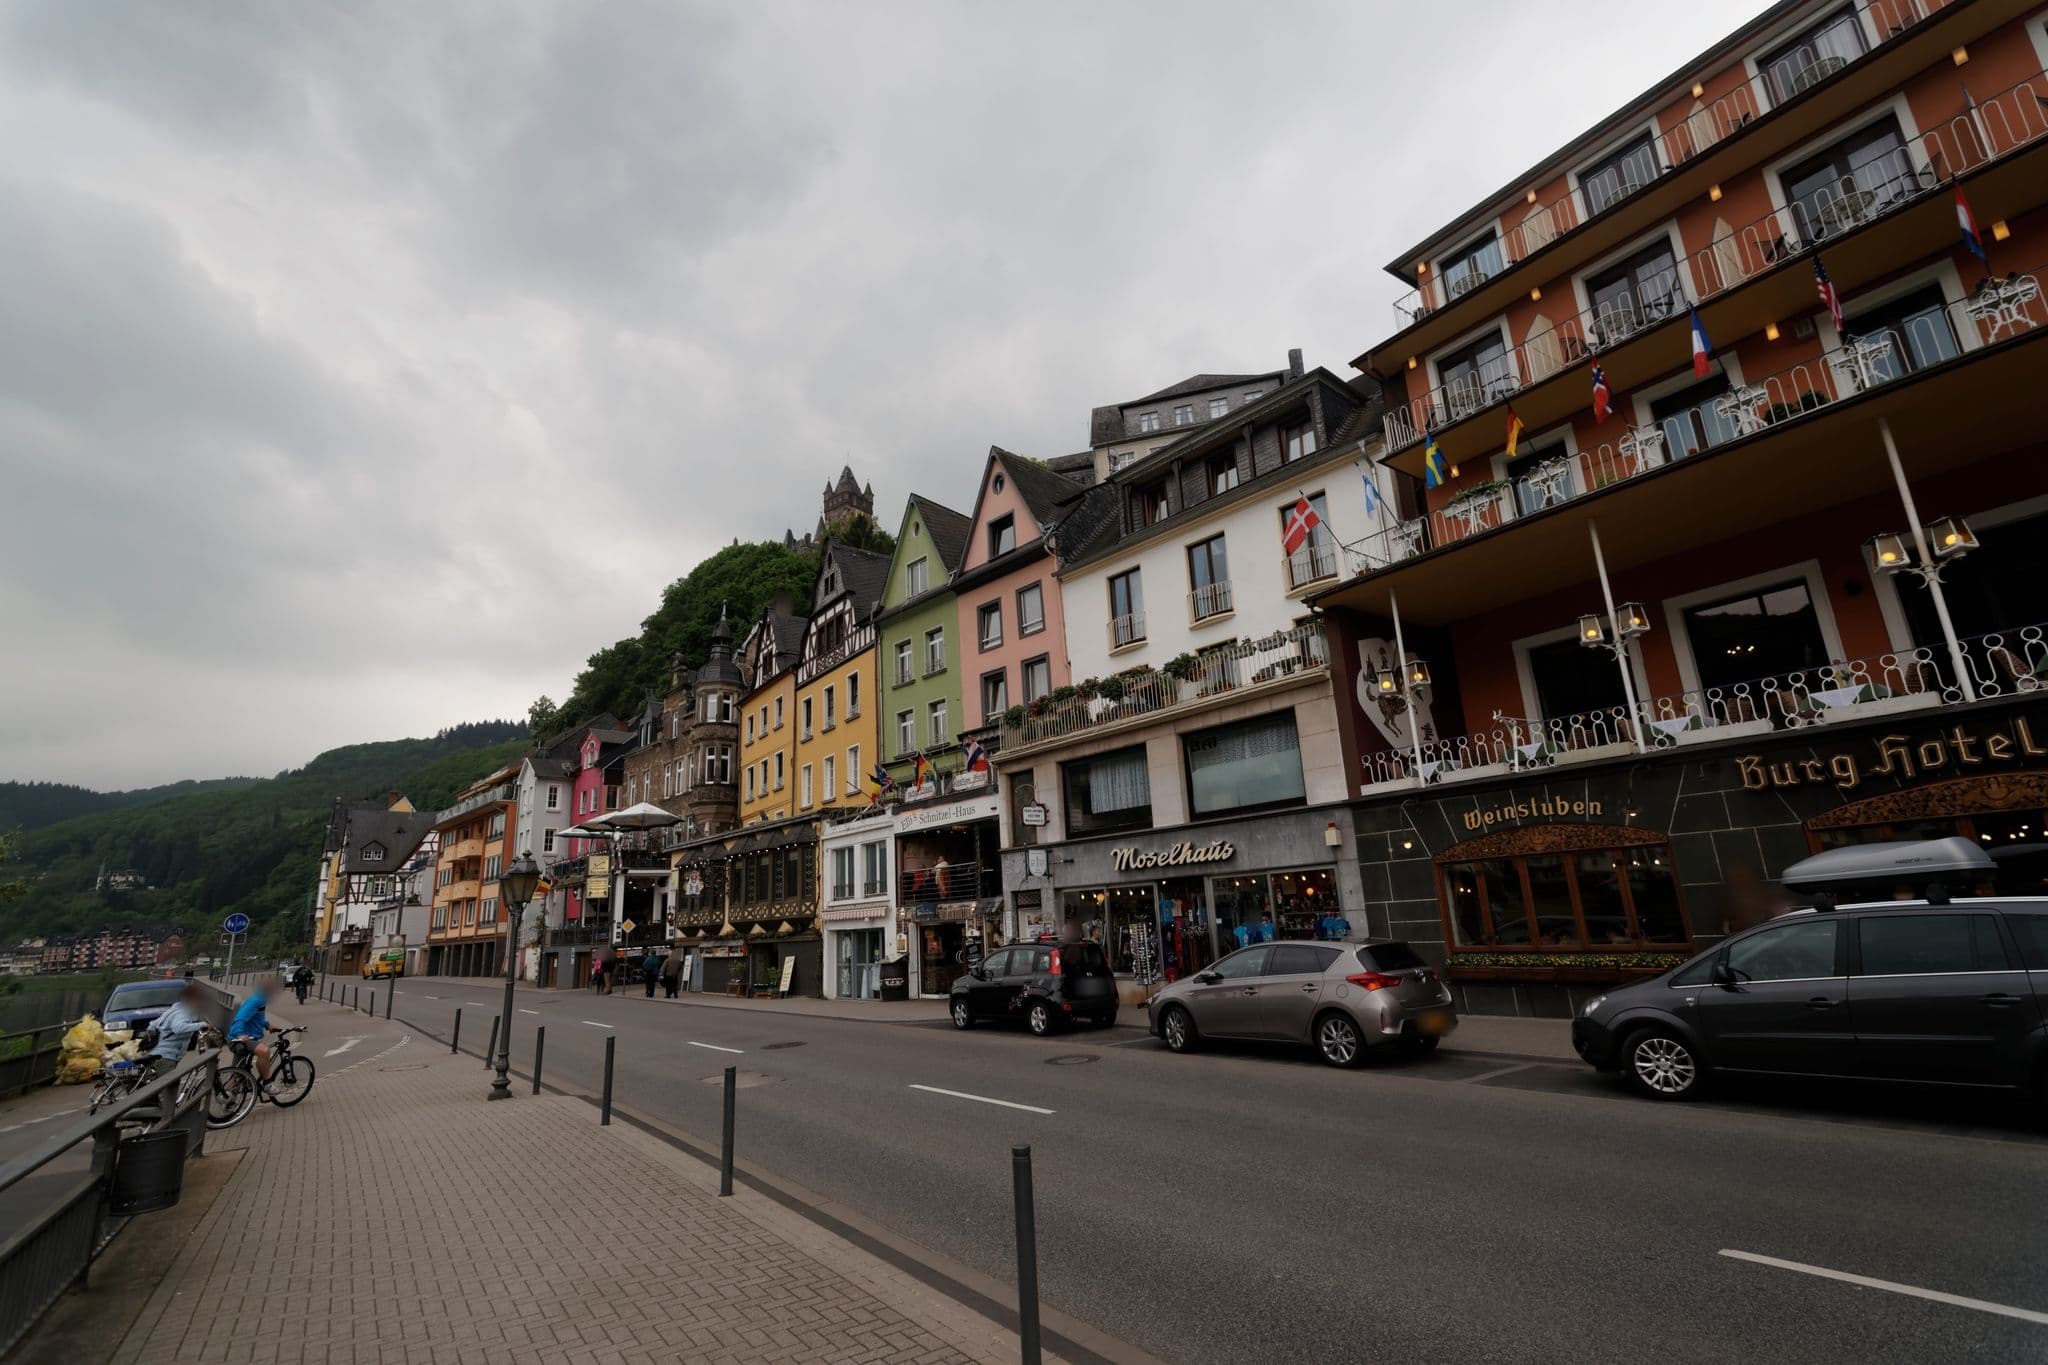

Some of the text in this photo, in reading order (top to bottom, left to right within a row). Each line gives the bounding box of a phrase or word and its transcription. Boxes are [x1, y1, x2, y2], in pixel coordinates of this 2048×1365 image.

[1735, 714, 2048, 791] Burg Hotel
[1462, 794, 1605, 831] Weinstuben
[1110, 840, 1235, 871] Moselhaus
